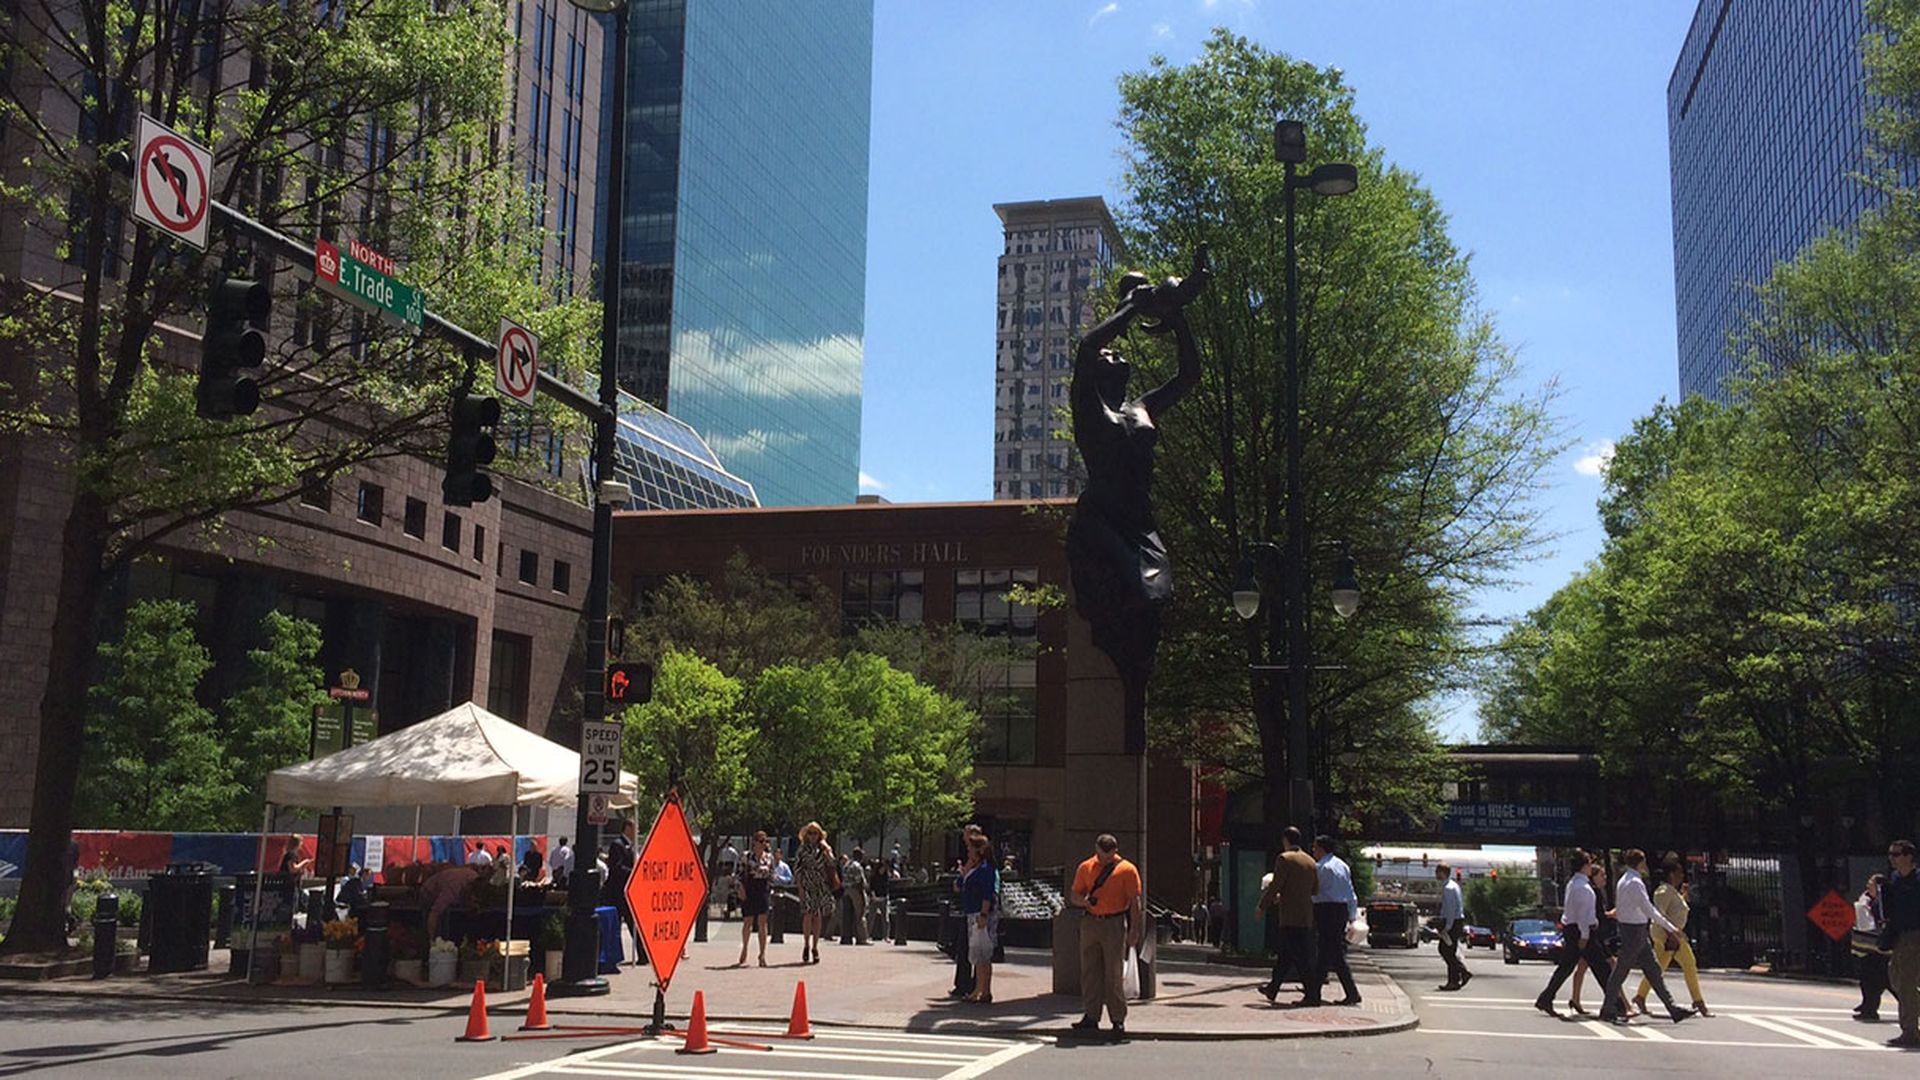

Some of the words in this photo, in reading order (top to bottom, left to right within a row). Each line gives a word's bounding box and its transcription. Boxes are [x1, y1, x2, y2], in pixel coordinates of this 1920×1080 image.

[350, 241, 393, 277] NORTH
[339, 256, 351, 286] E.
[353, 265, 394, 308] Trade
[801, 543, 901, 563] FOUNDERS
[913, 541, 969, 562] HALL
[585, 728, 619, 742] SPEED
[587, 744, 614, 757] LIMIT
[583, 758, 616, 785] 25
[1488, 804, 1516, 818] HUGE
[643, 861, 668, 880] RIGHT
[673, 861, 694, 881] LANE
[652, 891, 684, 912] CLOSED
[653, 920, 681, 941] AHEAD
